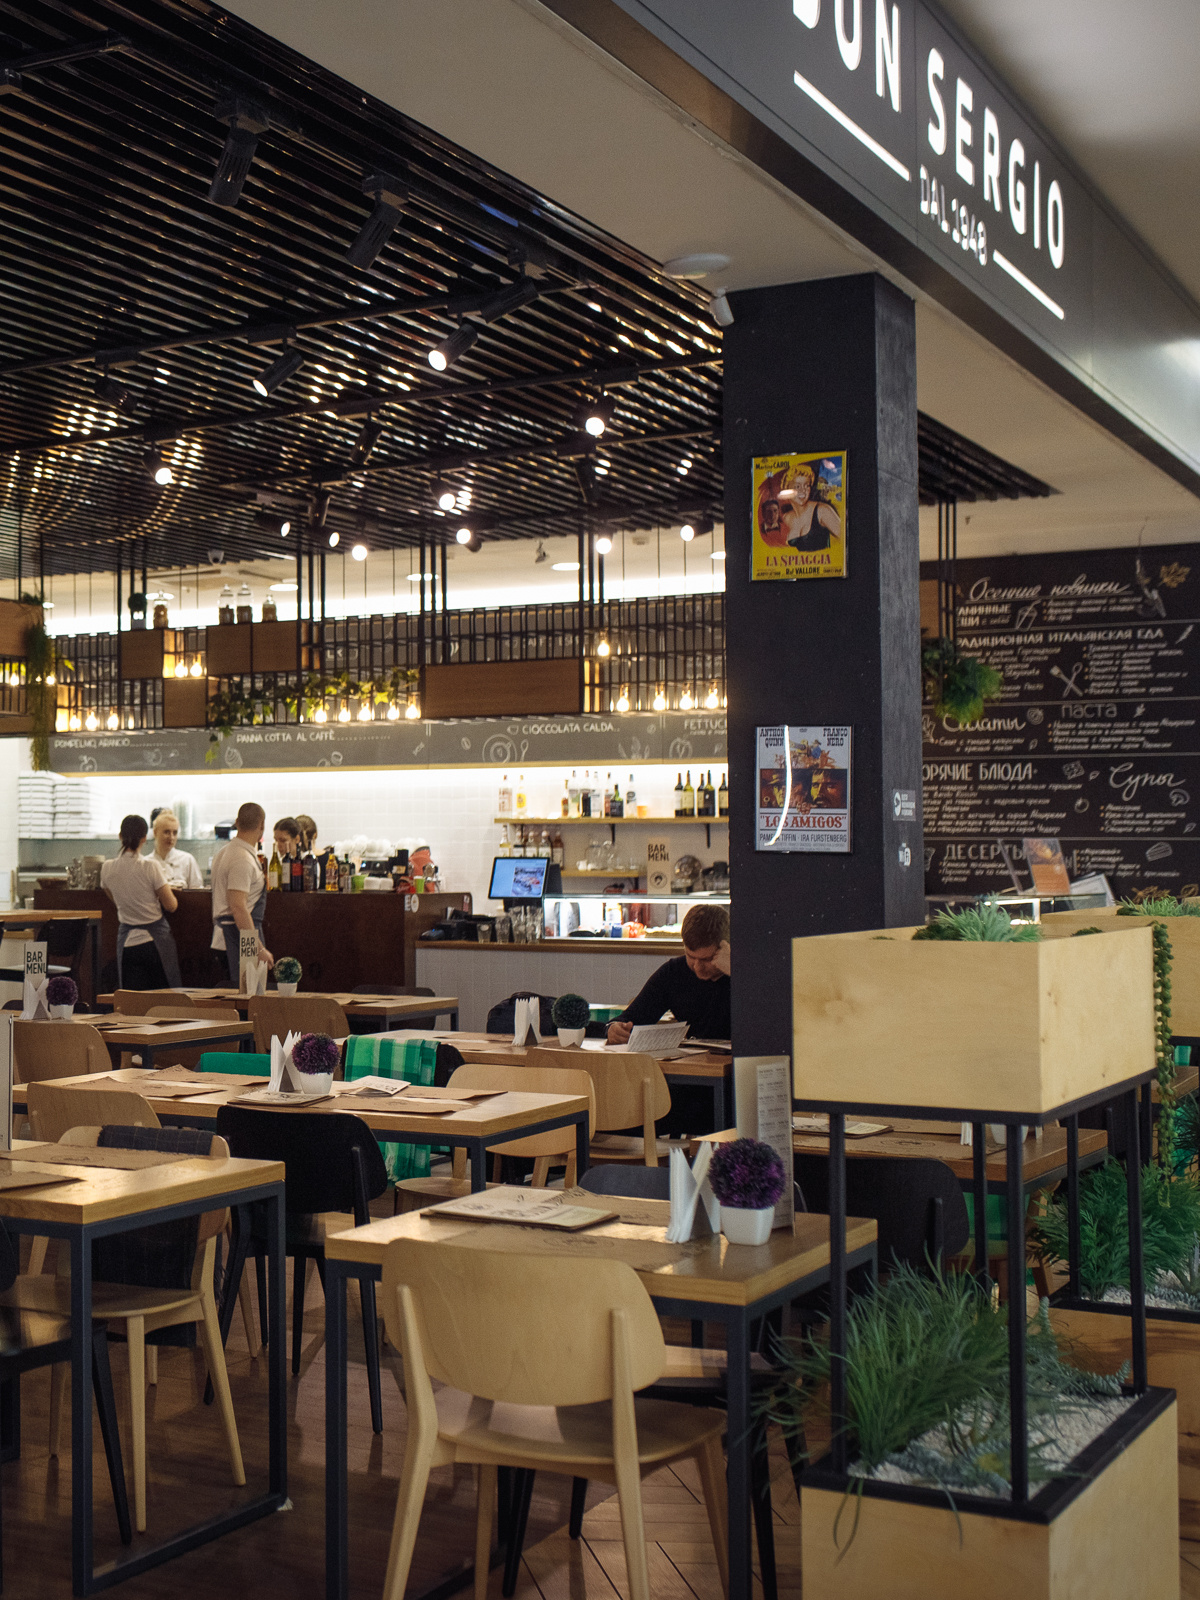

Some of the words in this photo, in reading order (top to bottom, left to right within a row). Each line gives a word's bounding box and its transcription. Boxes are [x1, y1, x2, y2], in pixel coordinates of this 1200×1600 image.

[792, 0, 901, 113] ON
[927, 47, 1065, 270] SERGIO
[920, 164, 950, 233] DAL
[951, 198, 987, 266] 1948
[773, 461, 791, 469] CAROL
[766, 556, 778, 567] LA
[780, 553, 831, 567] SPIAGGIA
[795, 566, 820, 575] VALLONE
[957, 603, 1012, 617] АМИННЫЕ
[957, 633, 1043, 649] РАДИЦИОННАЯ
[1049, 629, 1133, 643] ИТАЛЬЯНСКАЯ
[1137, 627, 1164, 640] ЕДА
[522, 723, 580, 735] CIOCCOLATA
[759, 728, 785, 738] ANTHON
[823, 728, 848, 738] FRANCO
[236, 732, 263, 744] PANNA
[265, 732, 293, 742] COTTA
[297, 732, 307, 742] AL
[764, 738, 785, 748] QUINN
[827, 738, 844, 747] NERO
[922, 762, 973, 781] ОРЯЧИЕ
[979, 762, 1033, 782] БЛЮДА
[1109, 761, 1187, 802] Супы
[781, 834, 797, 842] TIFFIN
[800, 834, 810, 842] IRA
[810, 834, 847, 843] FURSTENBERG
[647, 843, 666, 853] BAR
[240, 937, 256, 947] BAR
[26, 951, 43, 963] BAR
